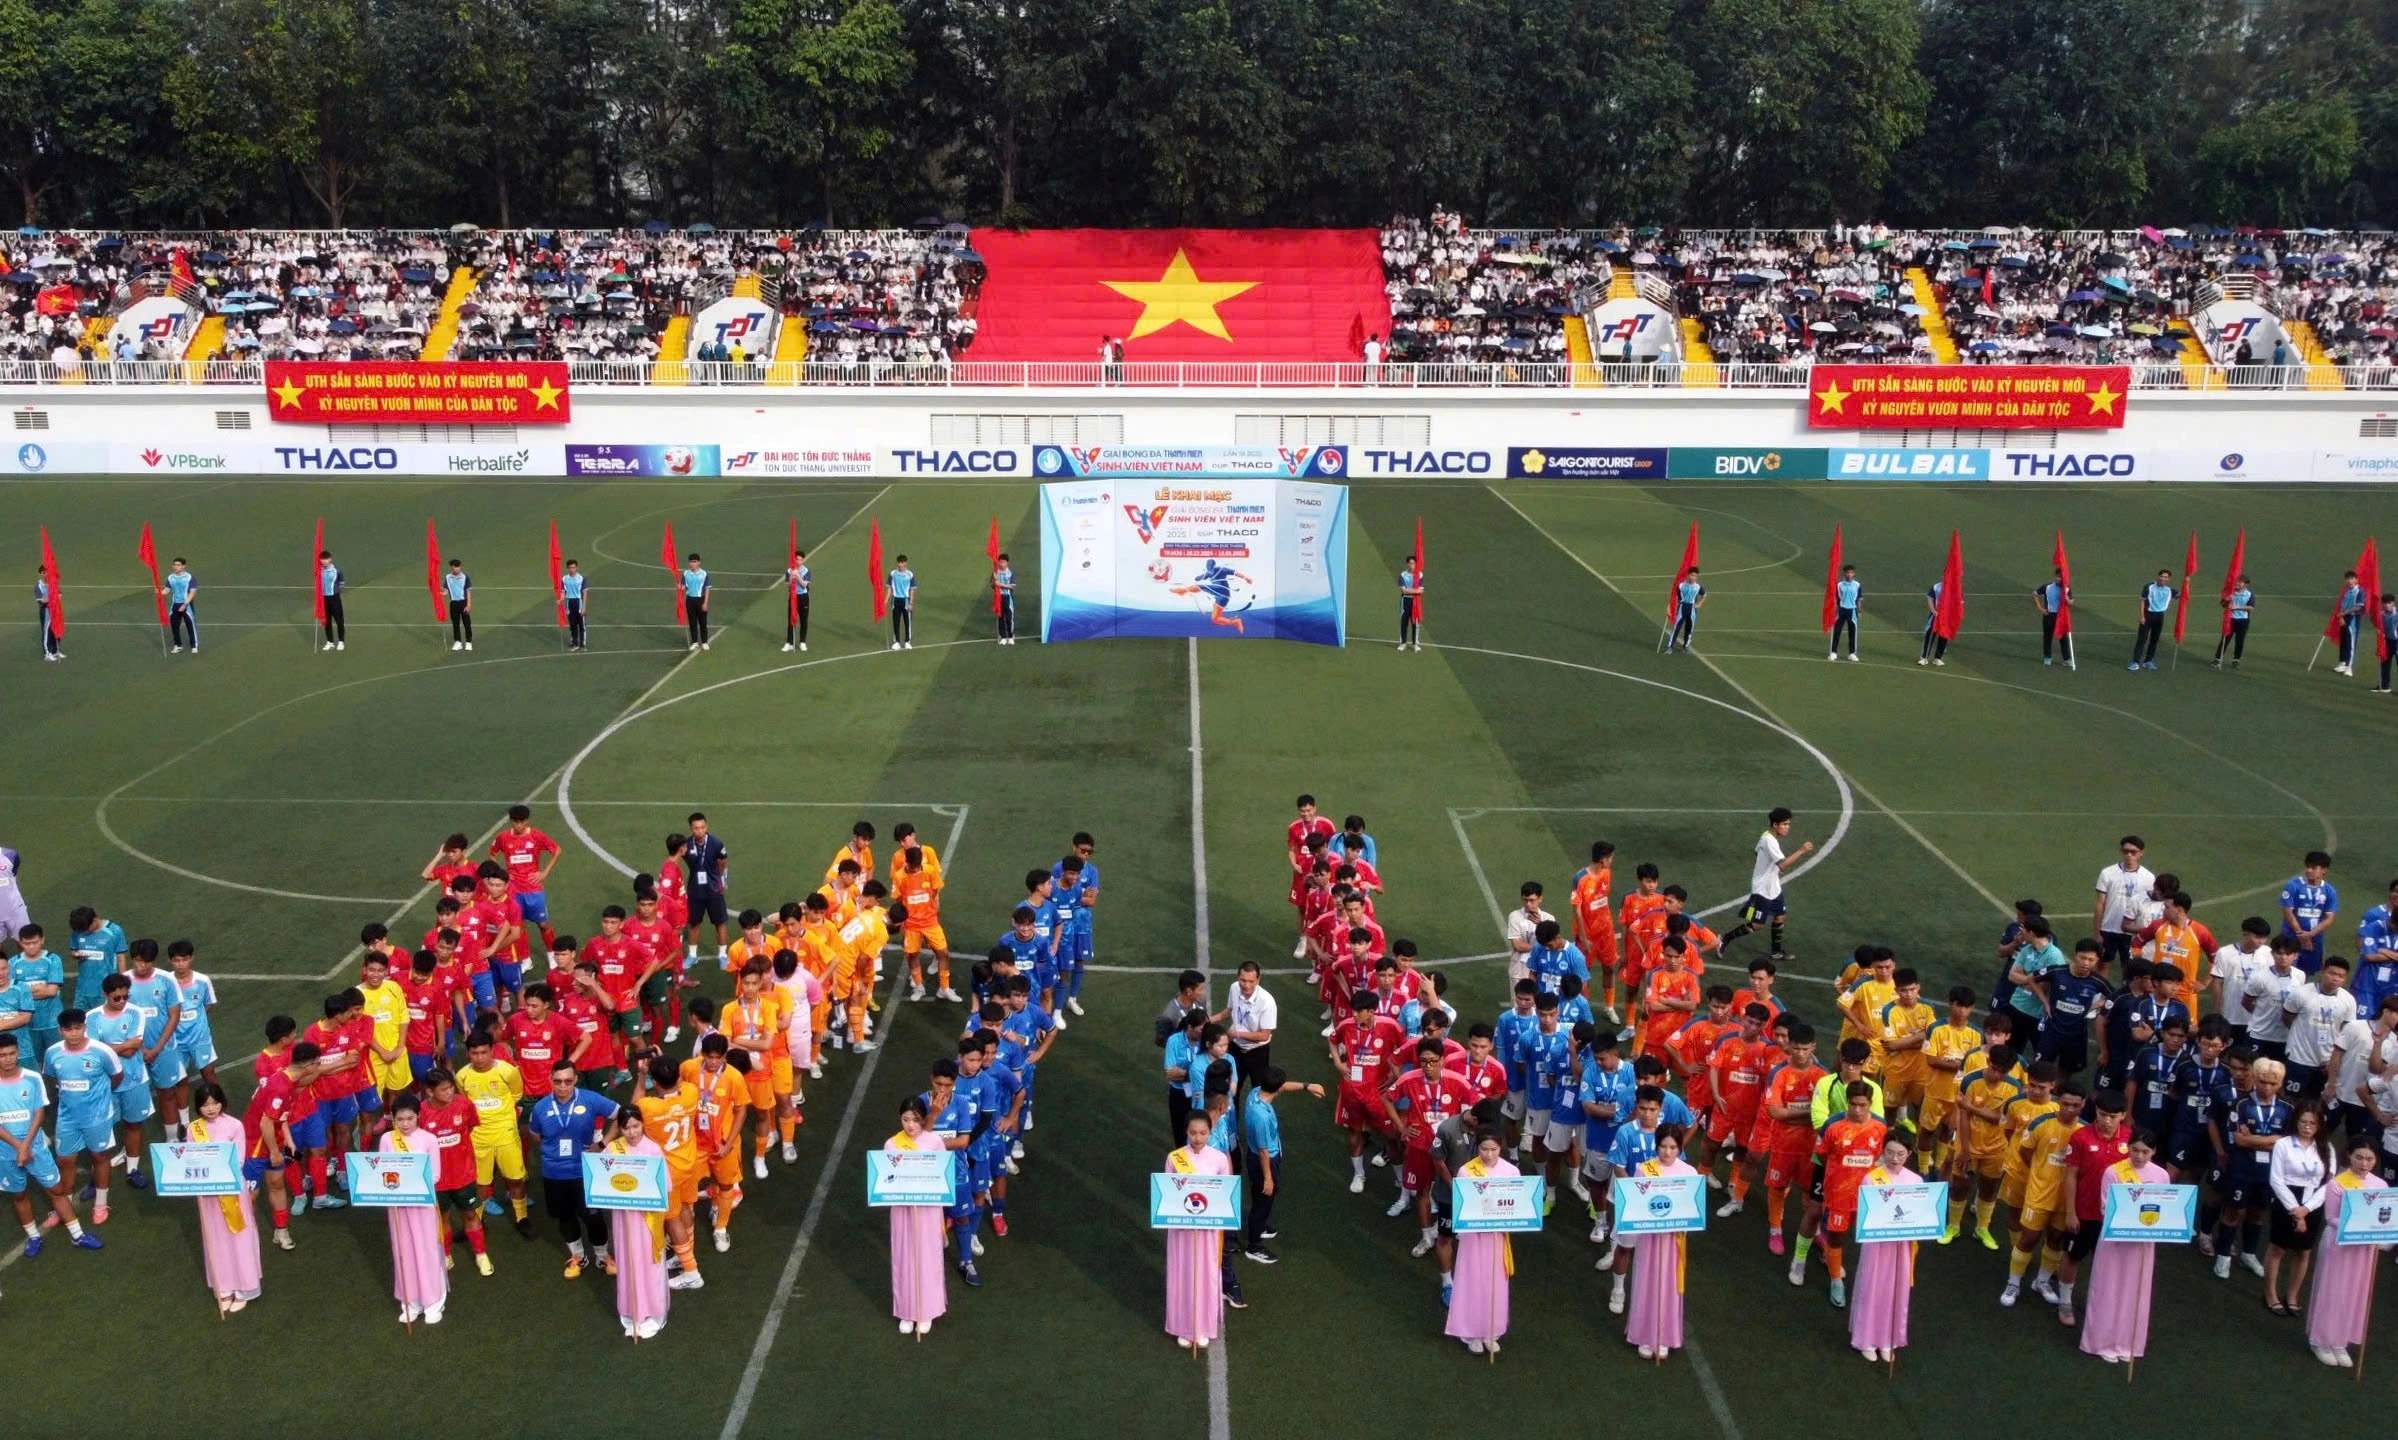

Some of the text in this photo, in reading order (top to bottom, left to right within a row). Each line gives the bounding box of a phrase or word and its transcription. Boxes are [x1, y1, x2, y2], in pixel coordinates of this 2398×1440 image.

[306, 374, 328, 388] UTH
[330, 370, 352, 388] SẴN
[354, 372, 383, 388] SÀNG
[386, 372, 416, 388] BƯỚC
[419, 372, 441, 388] VÀO
[460, 373, 503, 388] NGUYÊN
[506, 373, 528, 388] MỚI
[1852, 379, 1875, 393] UTH
[1878, 374, 1900, 393] SẴN
[1903, 376, 1933, 393] SÀNG
[1937, 376, 1968, 393] BƯỚC
[1971, 376, 1994, 393] VÀO
[2014, 377, 2059, 393] NGUYÊN
[2063, 376, 2086, 393] MỚI
[335, 396, 379, 411] NGUYÊN
[381, 396, 411, 411] VƯƠN
[413, 396, 443, 411] MÌNH
[446, 394, 469, 411] CỦA
[471, 395, 494, 411] DÂN
[496, 395, 518, 413] TỘC
[1880, 400, 1924, 416] NGUYÊN
[1928, 400, 1958, 416] VƯƠN
[1961, 399, 1992, 416] MÌNH
[1996, 398, 2019, 416] CỦA
[2022, 400, 2045, 416] DÂN
[2048, 400, 2070, 419] TỘC
[166, 454, 227, 469] VPBank
[274, 447, 398, 470] THACO
[448, 453, 524, 472] Herbalife
[764, 449, 872, 464] ĐẠI HỌC TÔN ĐỨC THẮNG
[892, 449, 1017, 473] THACO
[1365, 450, 1492, 474] THACO
[1548, 457, 1635, 468] SAIGONTOURIST
[574, 458, 640, 470] TERRA
[764, 464, 871, 473] TON DUC THANG UNIVERSITY
[1096, 462, 1123, 471] SINH
[1176, 462, 1203, 471] NAM
[1231, 461, 1273, 469] THACO
[1715, 456, 1764, 474] BIDV
[1840, 453, 1978, 474] BULBAL
[2006, 453, 2135, 476] THACO
[1154, 486, 1232, 503] LỄ KHAI MẠC
[1295, 498, 1322, 506] THACO
[1194, 515, 1216, 523] VIÊN
[2357, 1005, 2368, 1016] 15
[2286, 1080, 2300, 1093] 20
[663, 1115, 691, 1152] 21
[184, 1167, 210, 1178] STU
[1408, 1172, 1417, 1185] 10
[2213, 1170, 2220, 1181] 9
[2233, 1190, 2242, 1201] 3
[1497, 1199, 1515, 1207] SIU
[1649, 1202, 1671, 1210] SGU
[1441, 1217, 1452, 1229] 79
